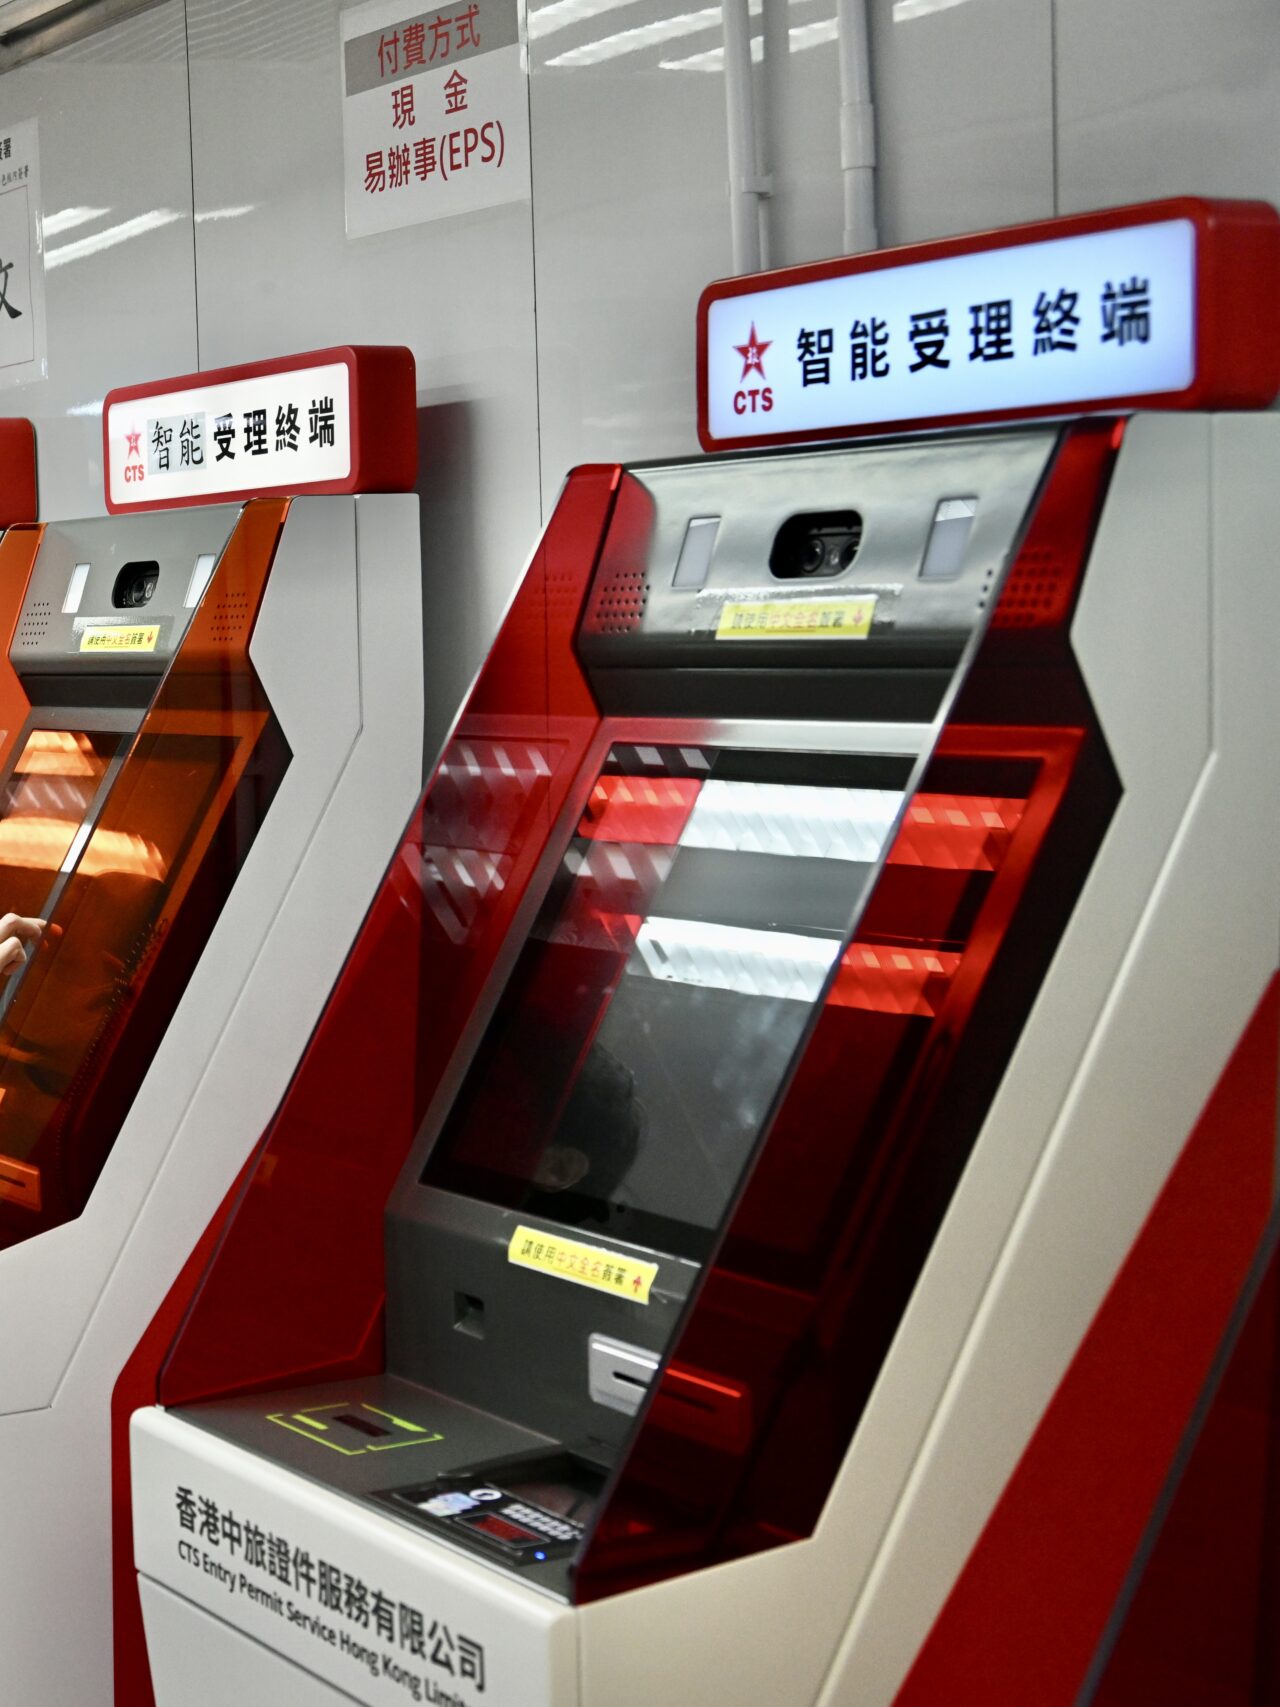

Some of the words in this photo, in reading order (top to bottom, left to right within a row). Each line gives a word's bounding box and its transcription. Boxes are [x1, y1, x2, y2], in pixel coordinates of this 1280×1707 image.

[377, 4, 481, 78] 付費方式
[364, 120, 505, 194] 易辦事(EPS)
[796, 276, 1151, 387] 智能受理終端
[152, 396, 335, 471] 智能受理終端
[733, 387, 774, 415] CTS
[124, 464, 145, 483] CTS
[176, 1485, 485, 1693] 香港中旅證件服務有限公司
[178, 1540, 200, 1567] CTS
[202, 1553, 236, 1593] Entry
[239, 1573, 284, 1617] Permit
[286, 1601, 336, 1646] Service
[339, 1630, 379, 1677] Hong
[382, 1654, 422, 1702] Kong
